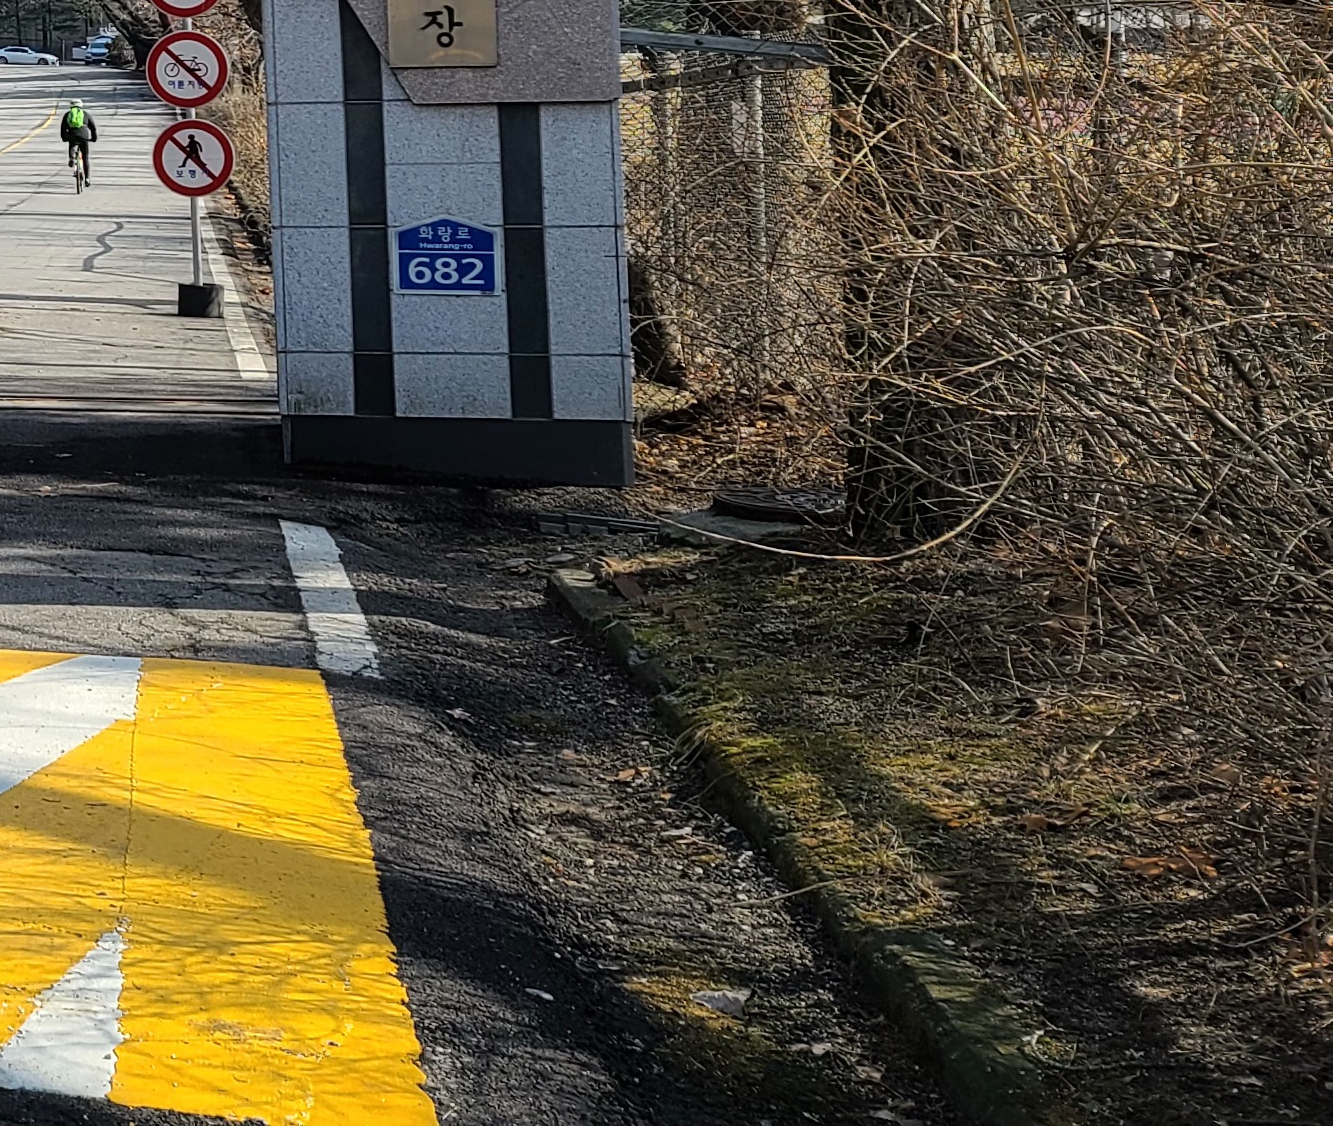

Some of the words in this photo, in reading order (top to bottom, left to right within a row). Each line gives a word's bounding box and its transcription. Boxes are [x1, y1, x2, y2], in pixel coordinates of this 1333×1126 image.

[418, 226, 471, 243] 화랑로
[419, 242, 474, 250] Hwarang-ro
[408, 257, 485, 285] 682
